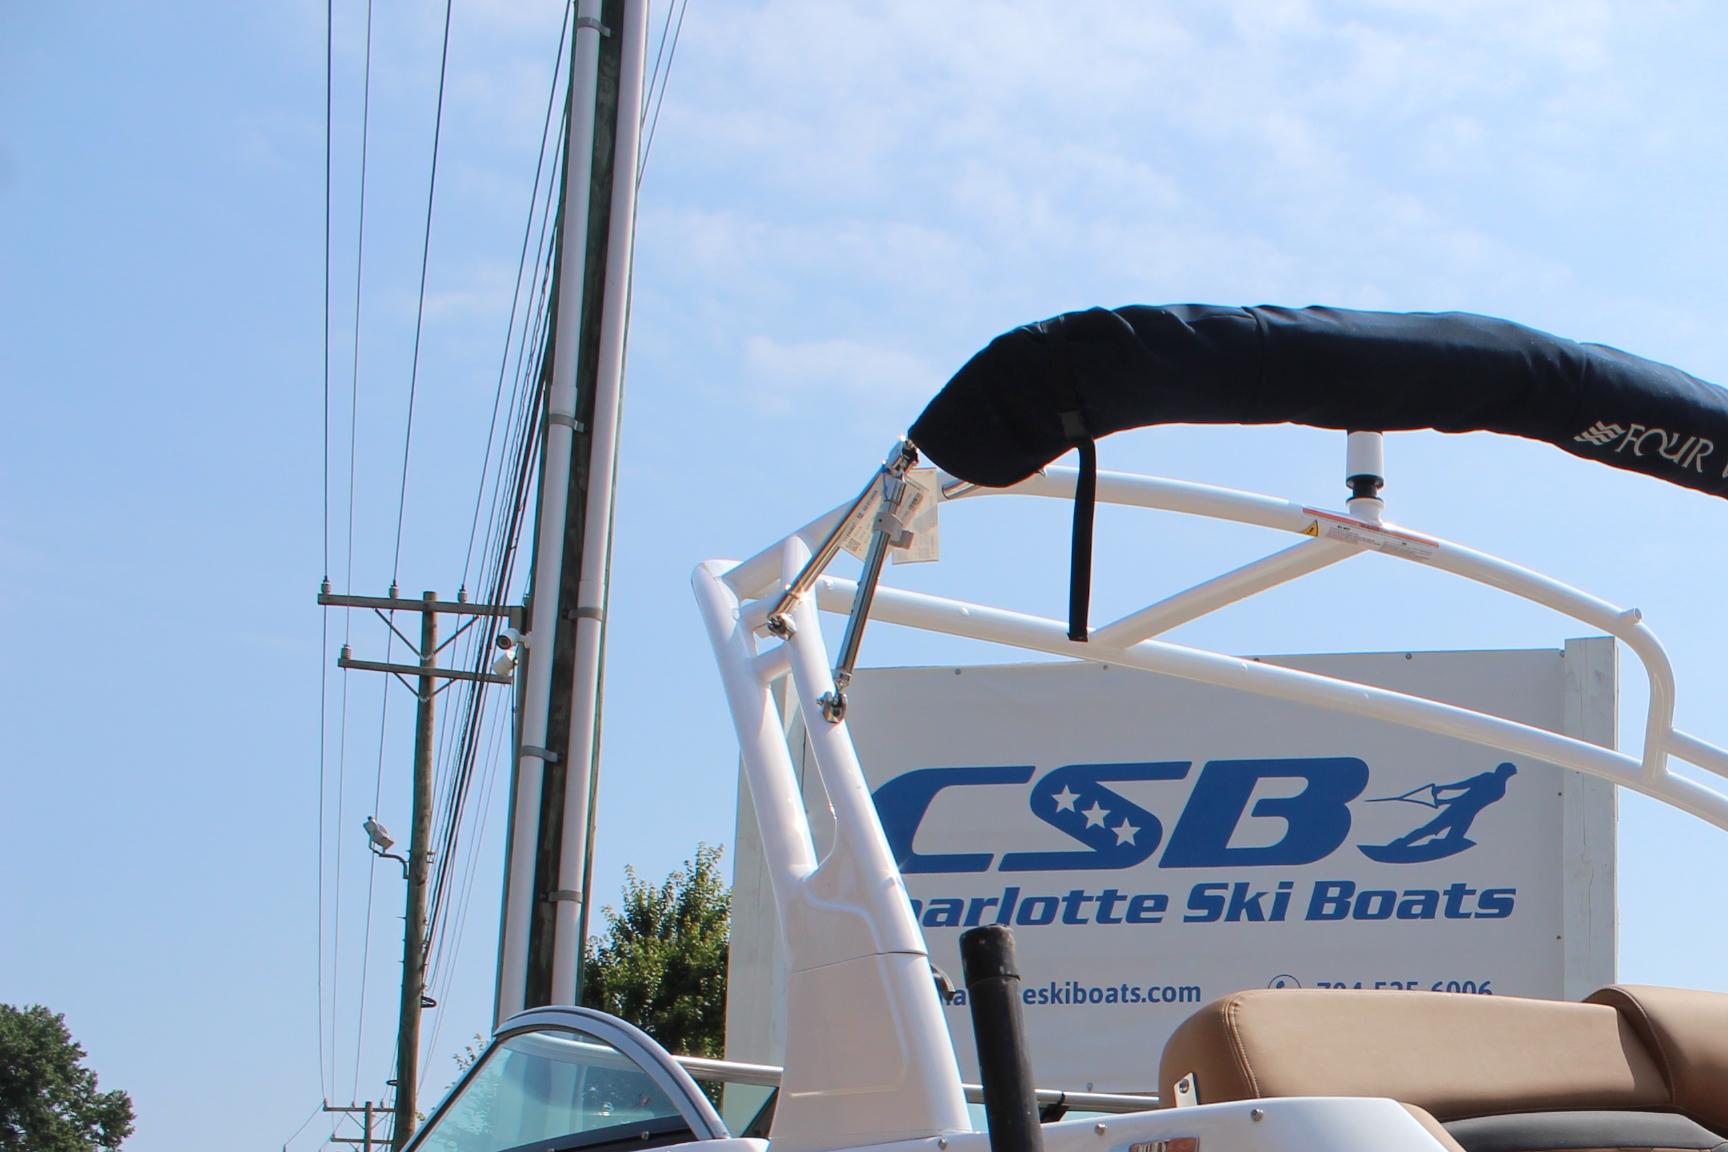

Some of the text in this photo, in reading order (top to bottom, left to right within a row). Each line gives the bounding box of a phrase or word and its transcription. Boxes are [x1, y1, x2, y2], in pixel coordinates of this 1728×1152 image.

[1616, 423, 1713, 472] FOUR
[872, 757, 1369, 874] CSB
[909, 879, 1517, 927] arlotte Ski Boats
